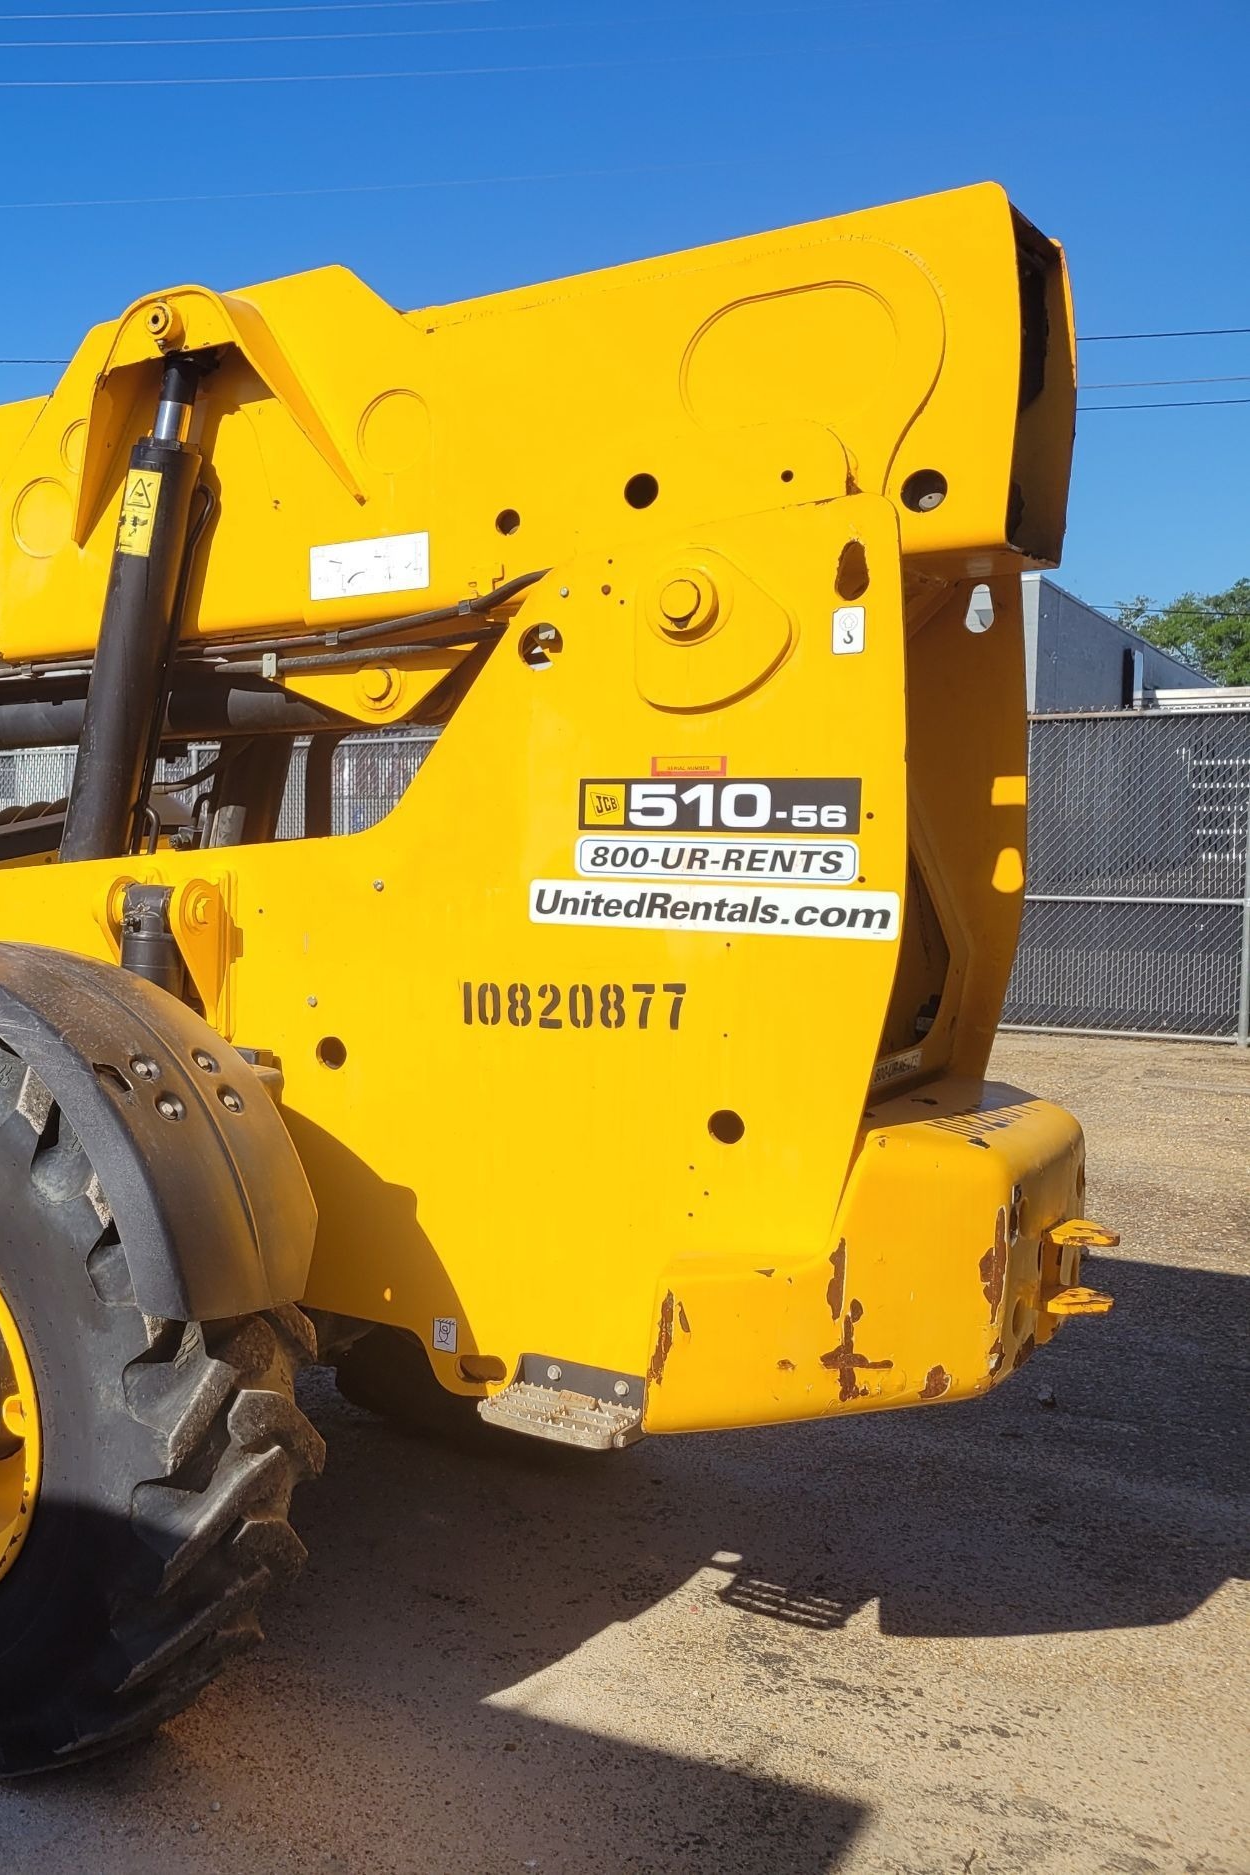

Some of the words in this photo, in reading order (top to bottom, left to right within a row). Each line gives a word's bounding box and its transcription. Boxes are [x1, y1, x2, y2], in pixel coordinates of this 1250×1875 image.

[595, 795, 618, 812] JCB
[590, 846, 844, 875] 800-UR-RENTS
[535, 888, 892, 930] UnitedRentals.com
[463, 981, 687, 1030] 10820877
